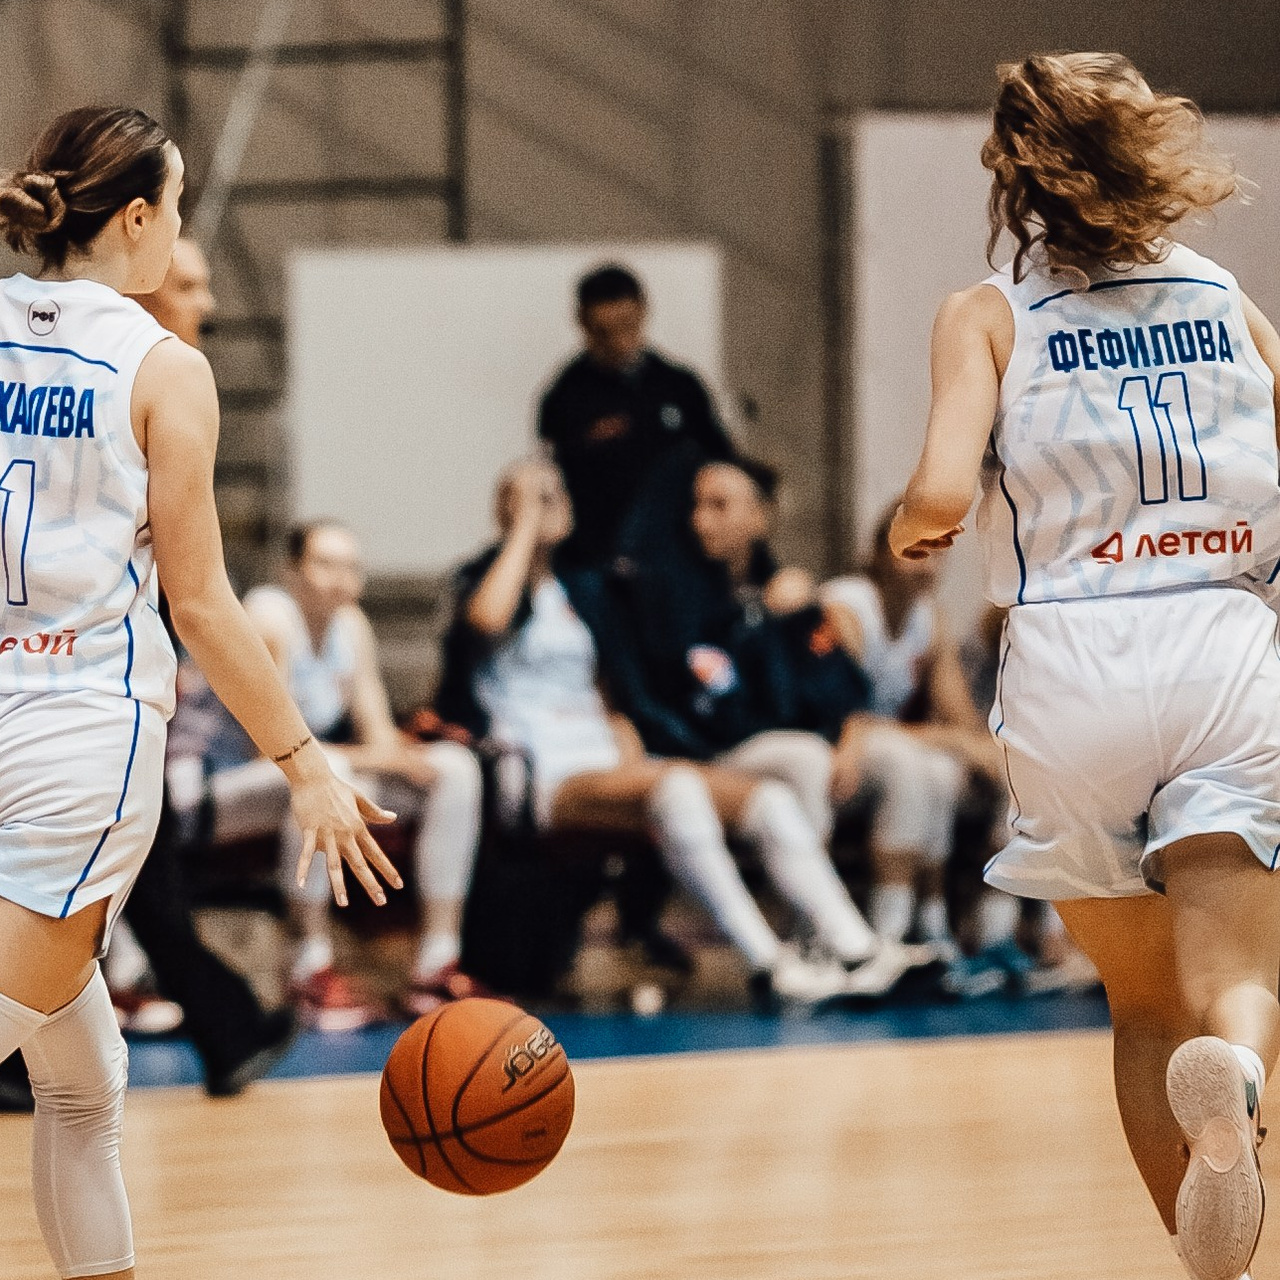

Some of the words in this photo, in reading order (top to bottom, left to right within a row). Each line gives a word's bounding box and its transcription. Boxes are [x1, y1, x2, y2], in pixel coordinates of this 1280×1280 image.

[1048, 320, 1234, 373] ФЕФИЛОВА
[1118, 372, 1206, 505] 11
[1135, 521, 1252, 558] летай
